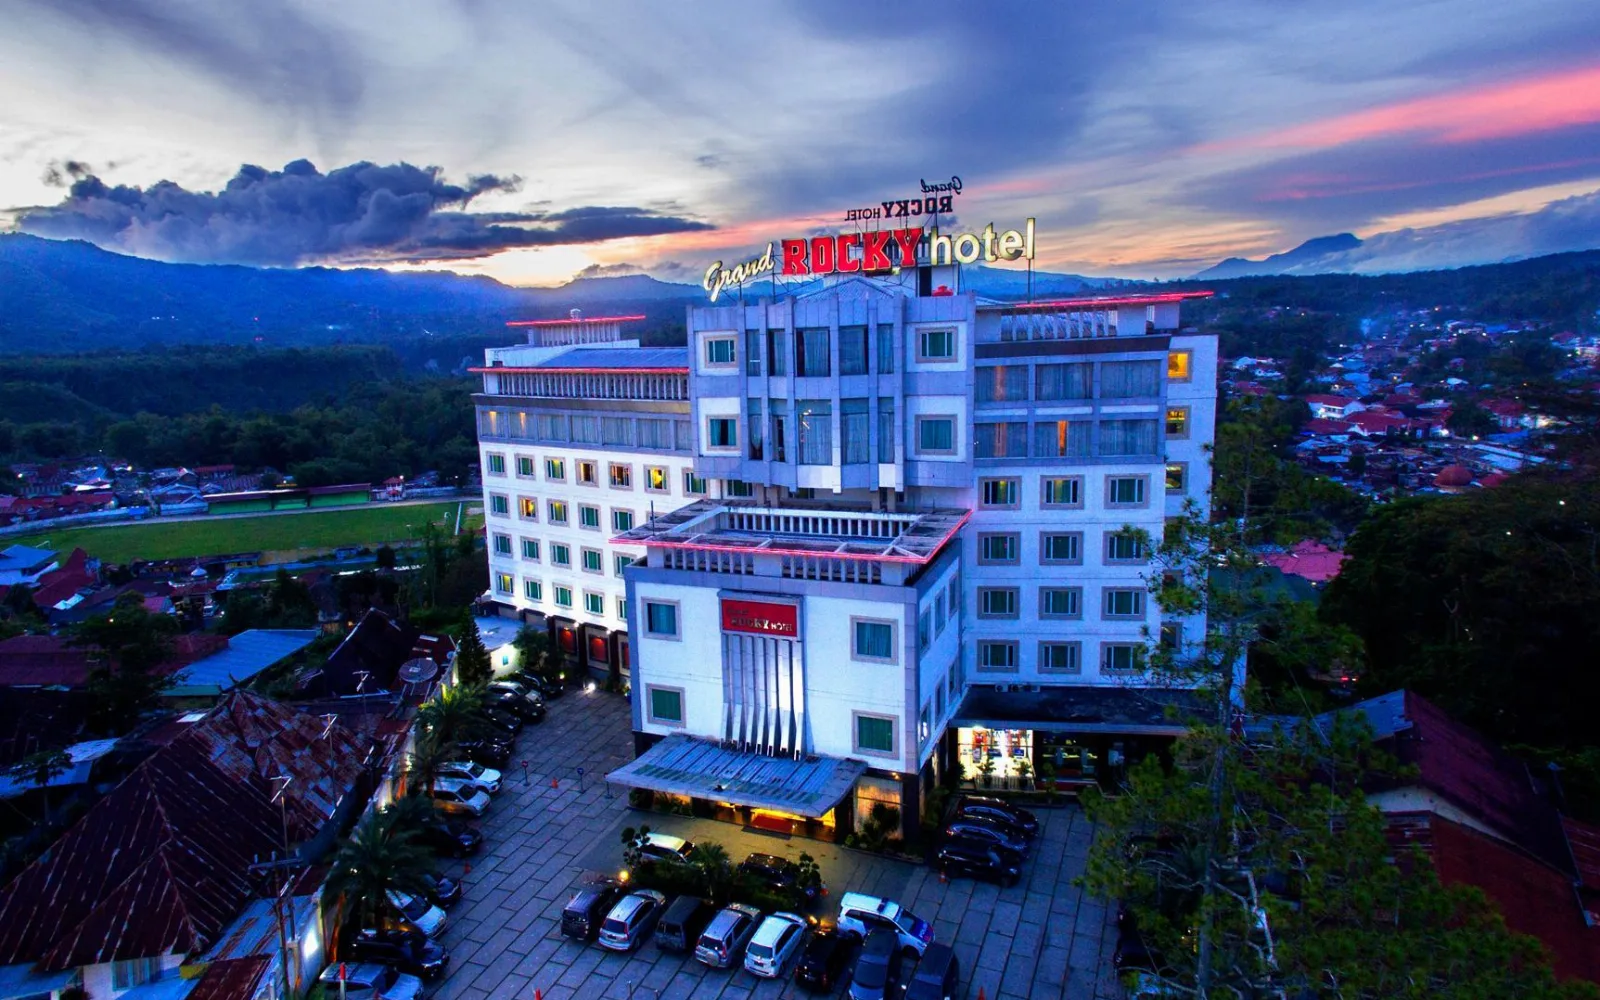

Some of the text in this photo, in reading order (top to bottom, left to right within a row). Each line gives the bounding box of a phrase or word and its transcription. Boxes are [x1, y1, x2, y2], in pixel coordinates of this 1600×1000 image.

[703, 217, 1036, 303] Grand ROCKY hotel
